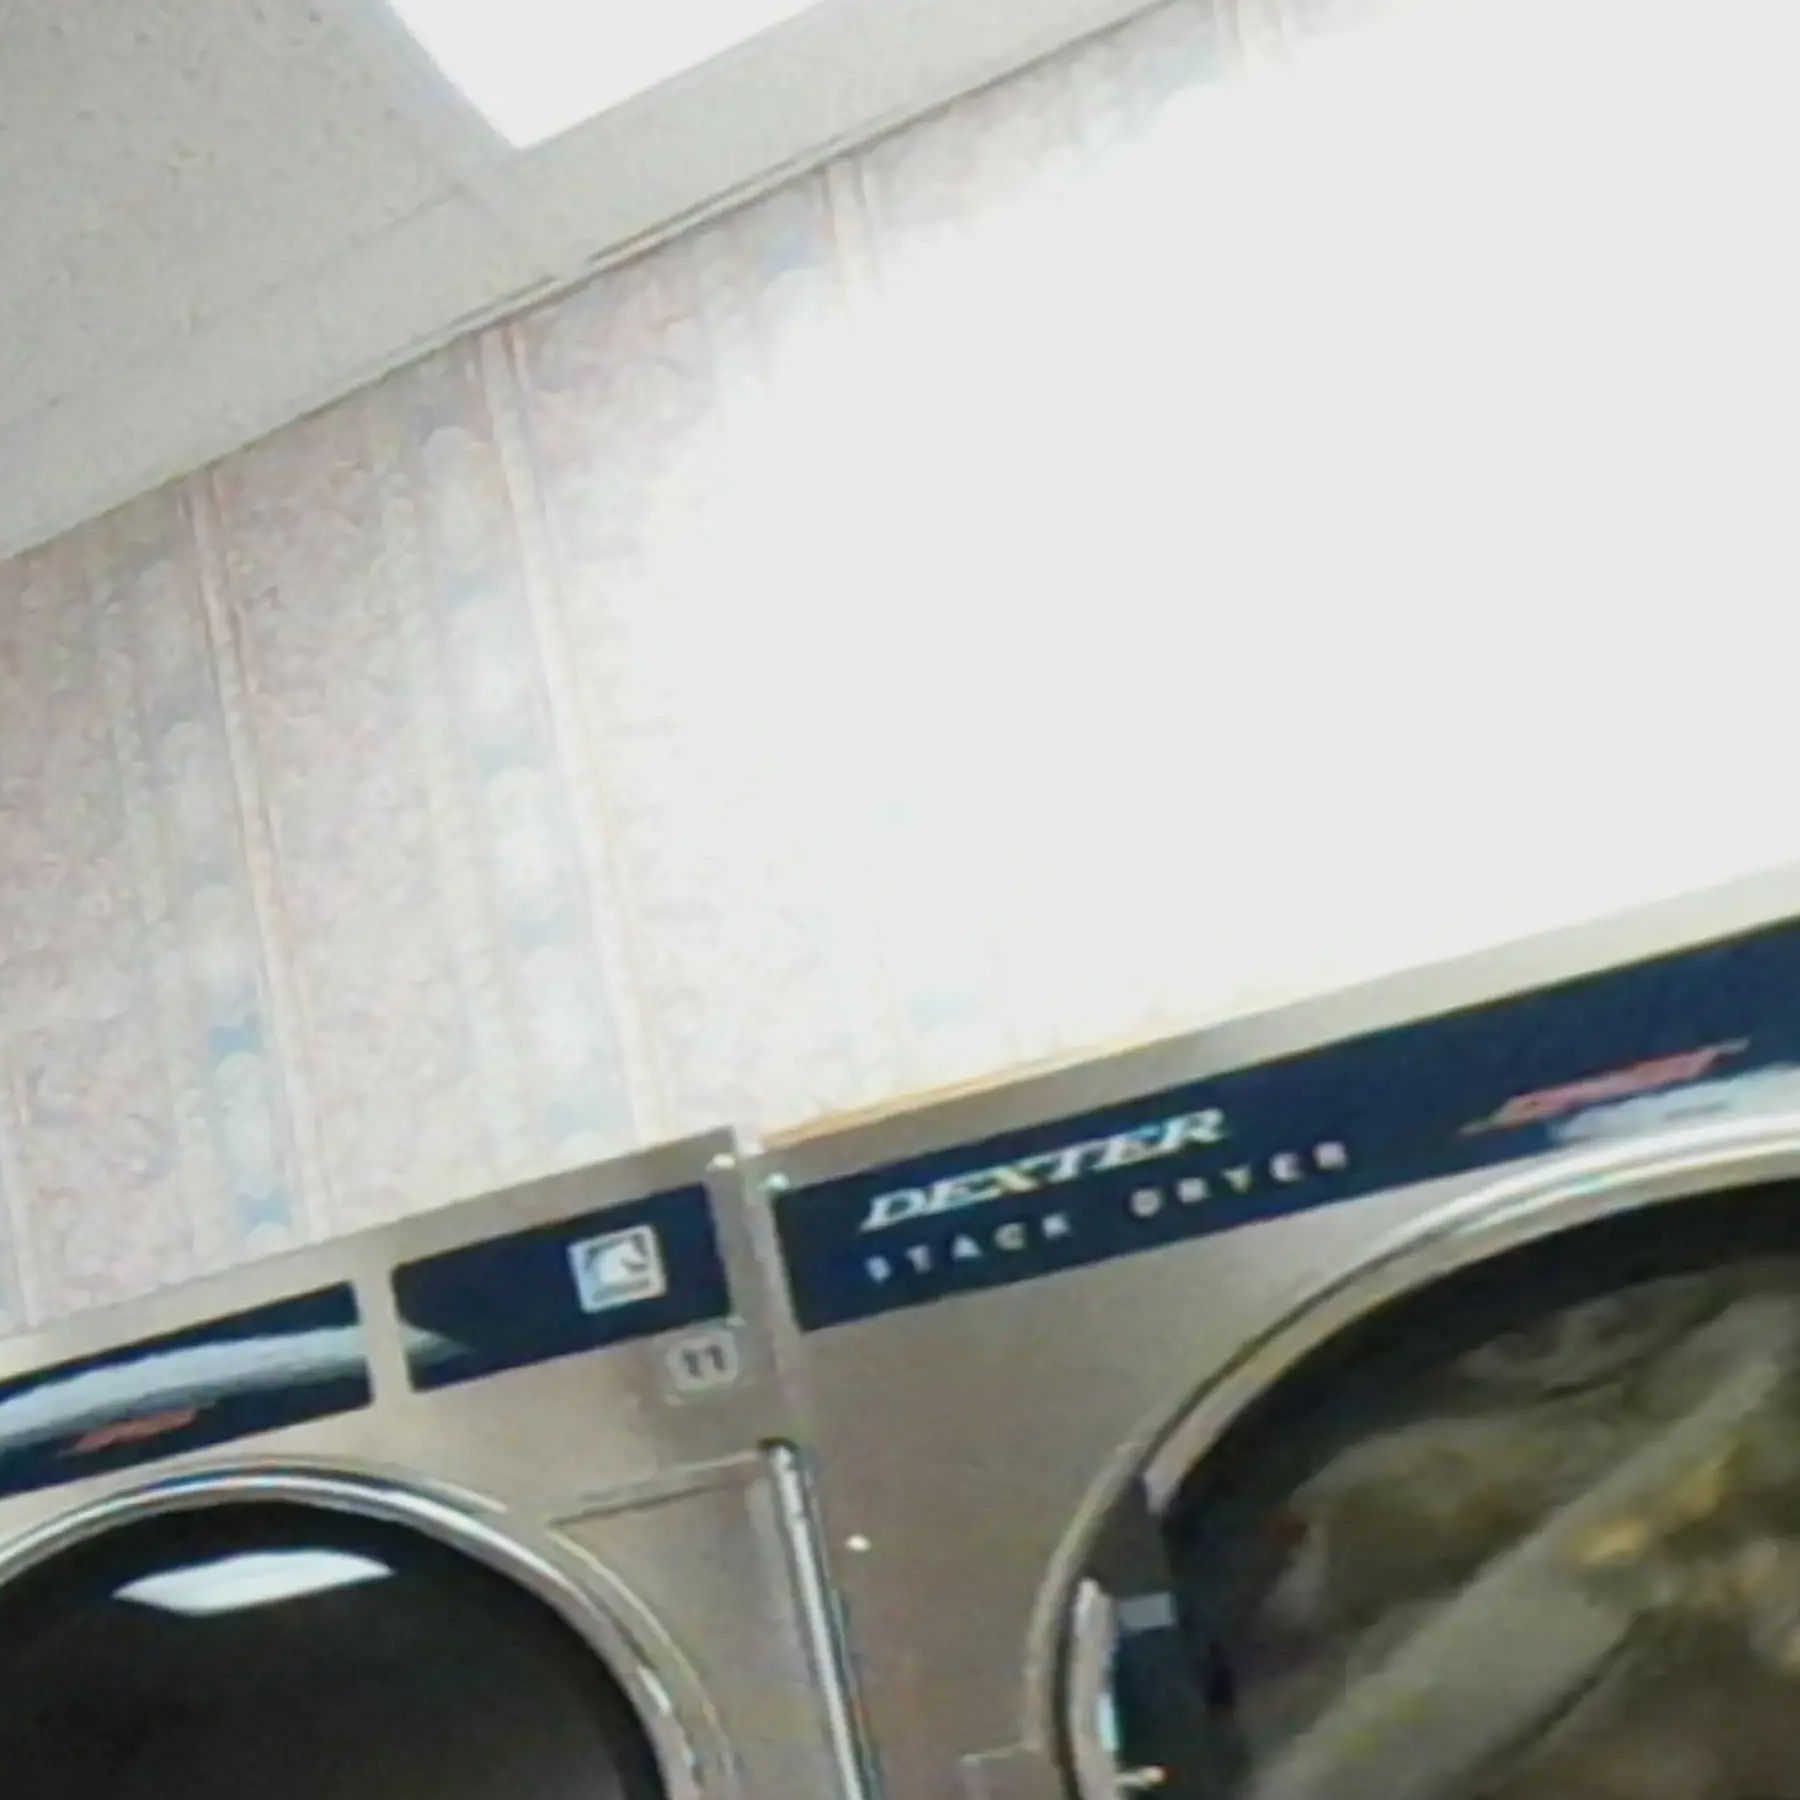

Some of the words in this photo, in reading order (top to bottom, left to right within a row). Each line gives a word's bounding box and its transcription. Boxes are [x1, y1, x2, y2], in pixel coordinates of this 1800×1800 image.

[859, 1108, 1226, 1232] DEXTER
[865, 1210, 1070, 1282] STACK
[1129, 1140, 1348, 1218] DRYER
